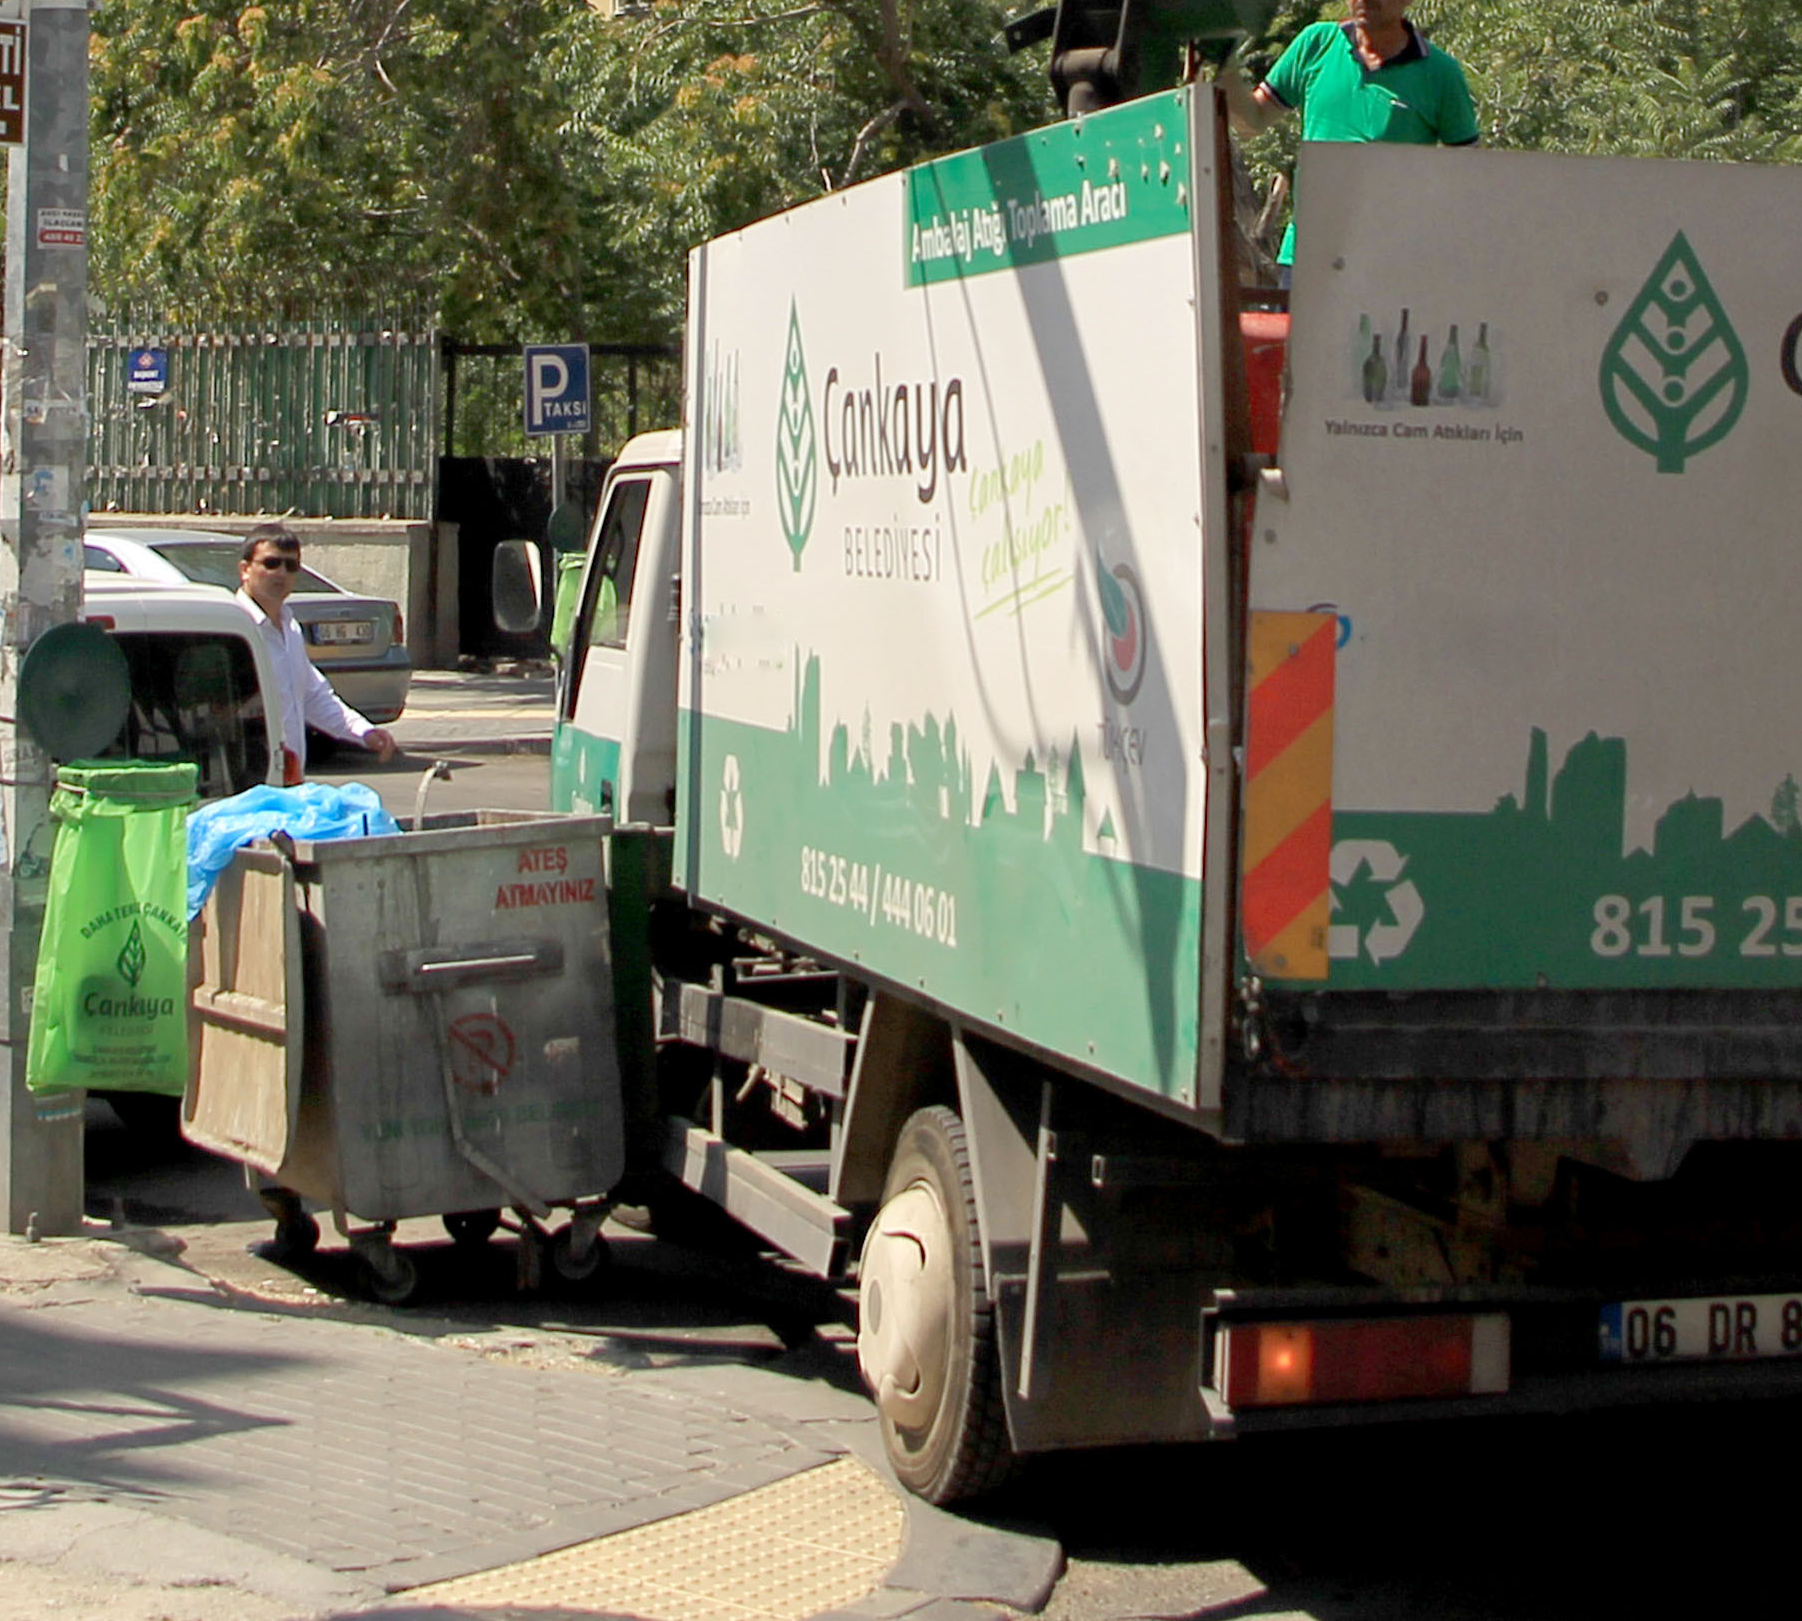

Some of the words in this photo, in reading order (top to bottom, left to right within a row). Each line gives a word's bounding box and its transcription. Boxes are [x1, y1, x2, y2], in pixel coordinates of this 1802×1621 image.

[912, 209, 972, 263] Ambalaj
[1007, 191, 1079, 248] Toplama
[824, 352, 967, 504] Çankaya
[1392, 422, 1428, 438] Cam
[845, 513, 940, 582] BELEDİYESİ
[518, 846, 568, 874] ATEŞ
[495, 878, 595, 910] ATMAYINIZ
[801, 845, 826, 898] 815
[828, 854, 847, 906] 25
[849, 862, 868, 914] 44
[882, 873, 910, 930] 444
[914, 882, 935, 938] 06
[937, 891, 957, 948] 01
[1590, 895, 1716, 957] 815
[1627, 1306, 1676, 1358] 06
[1708, 1301, 1757, 1355] DR
